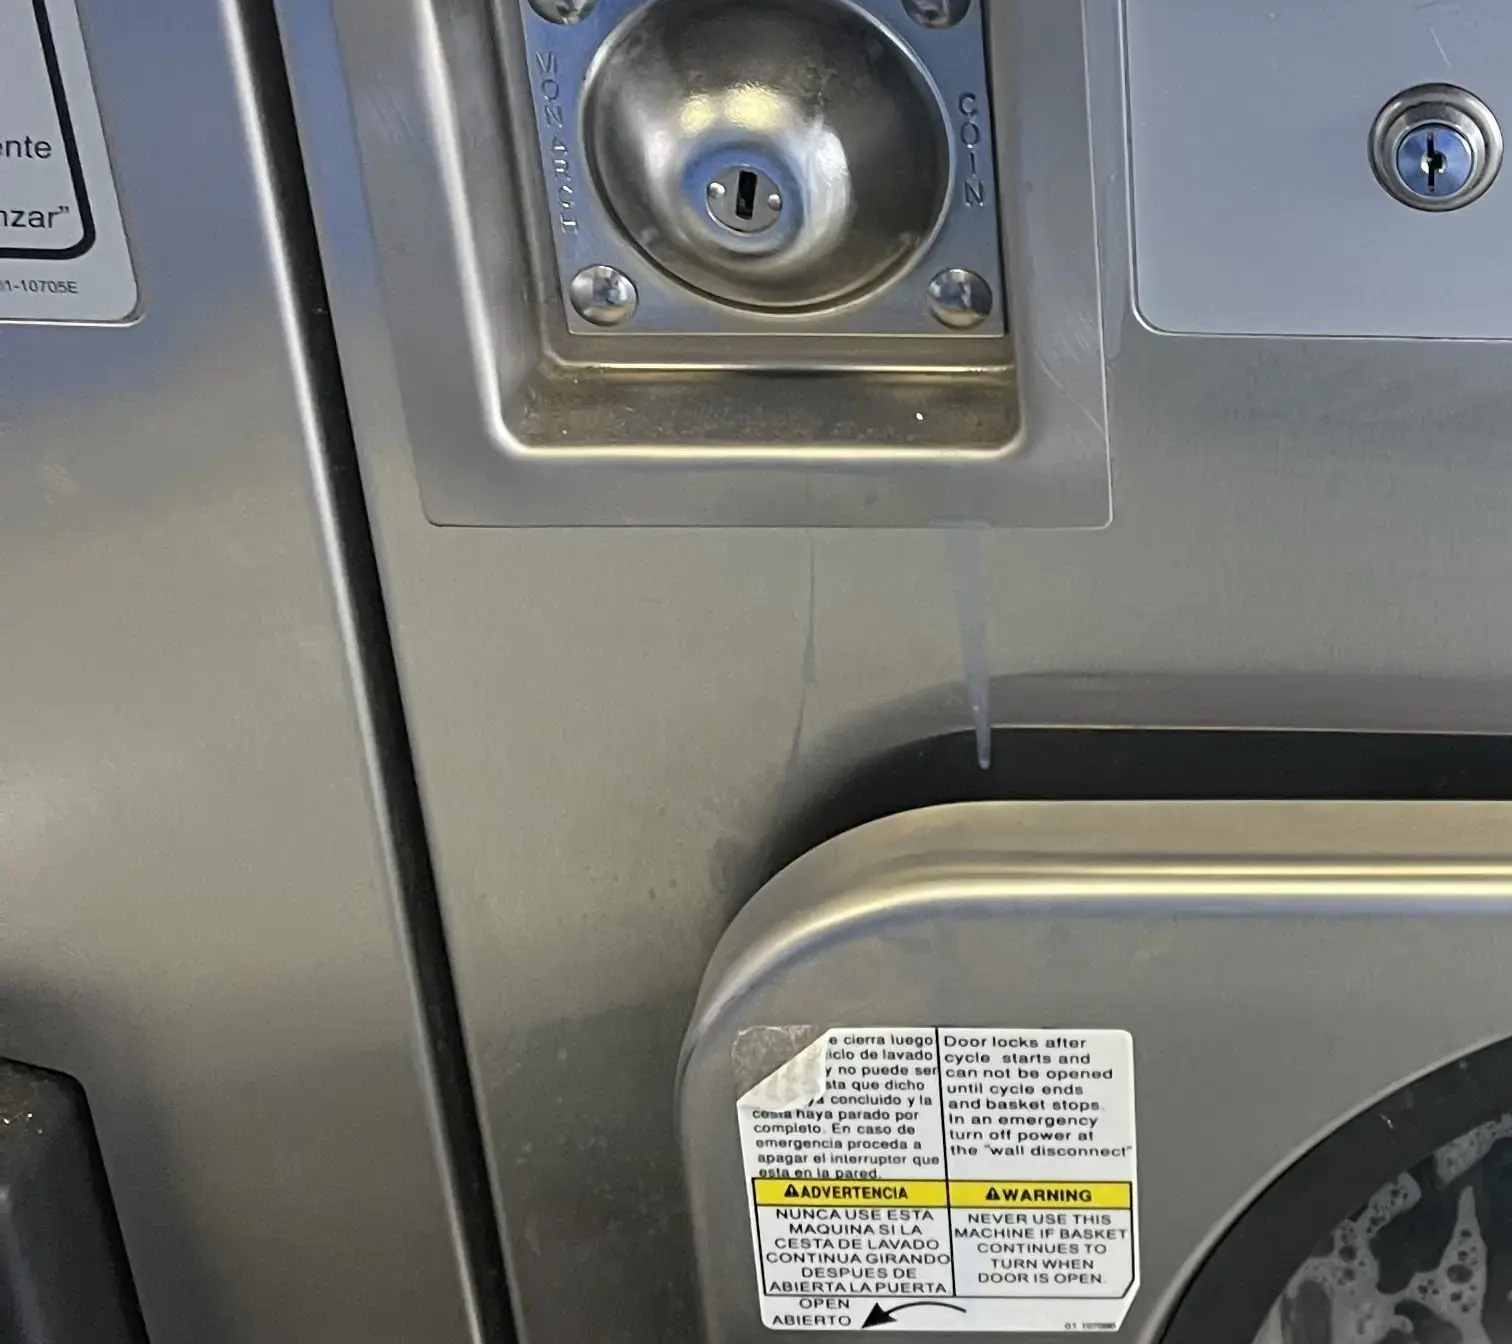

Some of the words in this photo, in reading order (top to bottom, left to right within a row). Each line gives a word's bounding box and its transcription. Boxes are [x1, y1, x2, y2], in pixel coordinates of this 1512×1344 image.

[843, 1034, 885, 1044] cierra
[890, 1034, 933, 1047] luego
[944, 1036, 986, 1048] Door
[992, 1036, 1038, 1048] locks
[1045, 1037, 1086, 1048] after
[882, 1049, 933, 1060] lavado
[944, 1053, 990, 1065] cycle
[1002, 1054, 1051, 1064] starts
[1058, 1053, 1090, 1064] and
[861, 1065, 908, 1077] puede
[945, 1069, 977, 1078] can
[983, 1068, 1010, 1078] not
[1046, 1068, 1113, 1081] opened
[884, 1080, 924, 1090] dicho
[947, 1083, 983, 1093] until
[989, 1083, 1034, 1096] cycle
[1042, 1084, 1083, 1095] ends
[830, 1095, 901, 1105] concluido
[948, 1098, 980, 1109] and
[986, 1099, 1045, 1110] basket
[796, 1109, 833, 1121] haya
[838, 1109, 889, 1122] parado
[998, 1116, 1098, 1127] emergency
[949, 1130, 982, 1139] turn
[989, 1130, 1011, 1140] off
[1018, 1131, 1071, 1142] power
[755, 1138, 842, 1150] emergencia
[847, 1138, 907, 1149] proceda
[950, 1145, 977, 1155] the
[757, 1154, 807, 1165] apagar
[830, 1153, 906, 1166] interruptor
[801, 1186, 908, 1200] ADVERTENCIA
[1003, 1188, 1092, 1201] WARNING
[776, 1208, 841, 1219] NUNCA
[845, 1209, 881, 1220] USE
[888, 1209, 934, 1220] ESTA
[968, 1213, 1027, 1224] NEVER
[1032, 1213, 1066, 1224] USE
[1072, 1214, 1111, 1225] THIS
[789, 1224, 874, 1234] MAQUINA
[954, 1228, 1035, 1239] MACHINE
[1059, 1228, 1127, 1239] BASKET
[774, 1238, 834, 1249] CESTA
[868, 1239, 939, 1250] LAVADO
[977, 1243, 1079, 1254] CONTINUES
[1084, 1243, 1107, 1254] TO
[766, 1252, 861, 1264] CONTINUA
[865, 1253, 950, 1264] GIRANDO
[990, 1258, 1037, 1269] TURN
[1042, 1259, 1093, 1269] WHEN
[801, 1267, 887, 1278] DESPUES
[978, 1272, 1028, 1283] DOOR
[769, 1281, 846, 1292] ABIERTA
[798, 1298, 849, 1308] OPEN
[772, 1315, 851, 1325] ABIERTO
